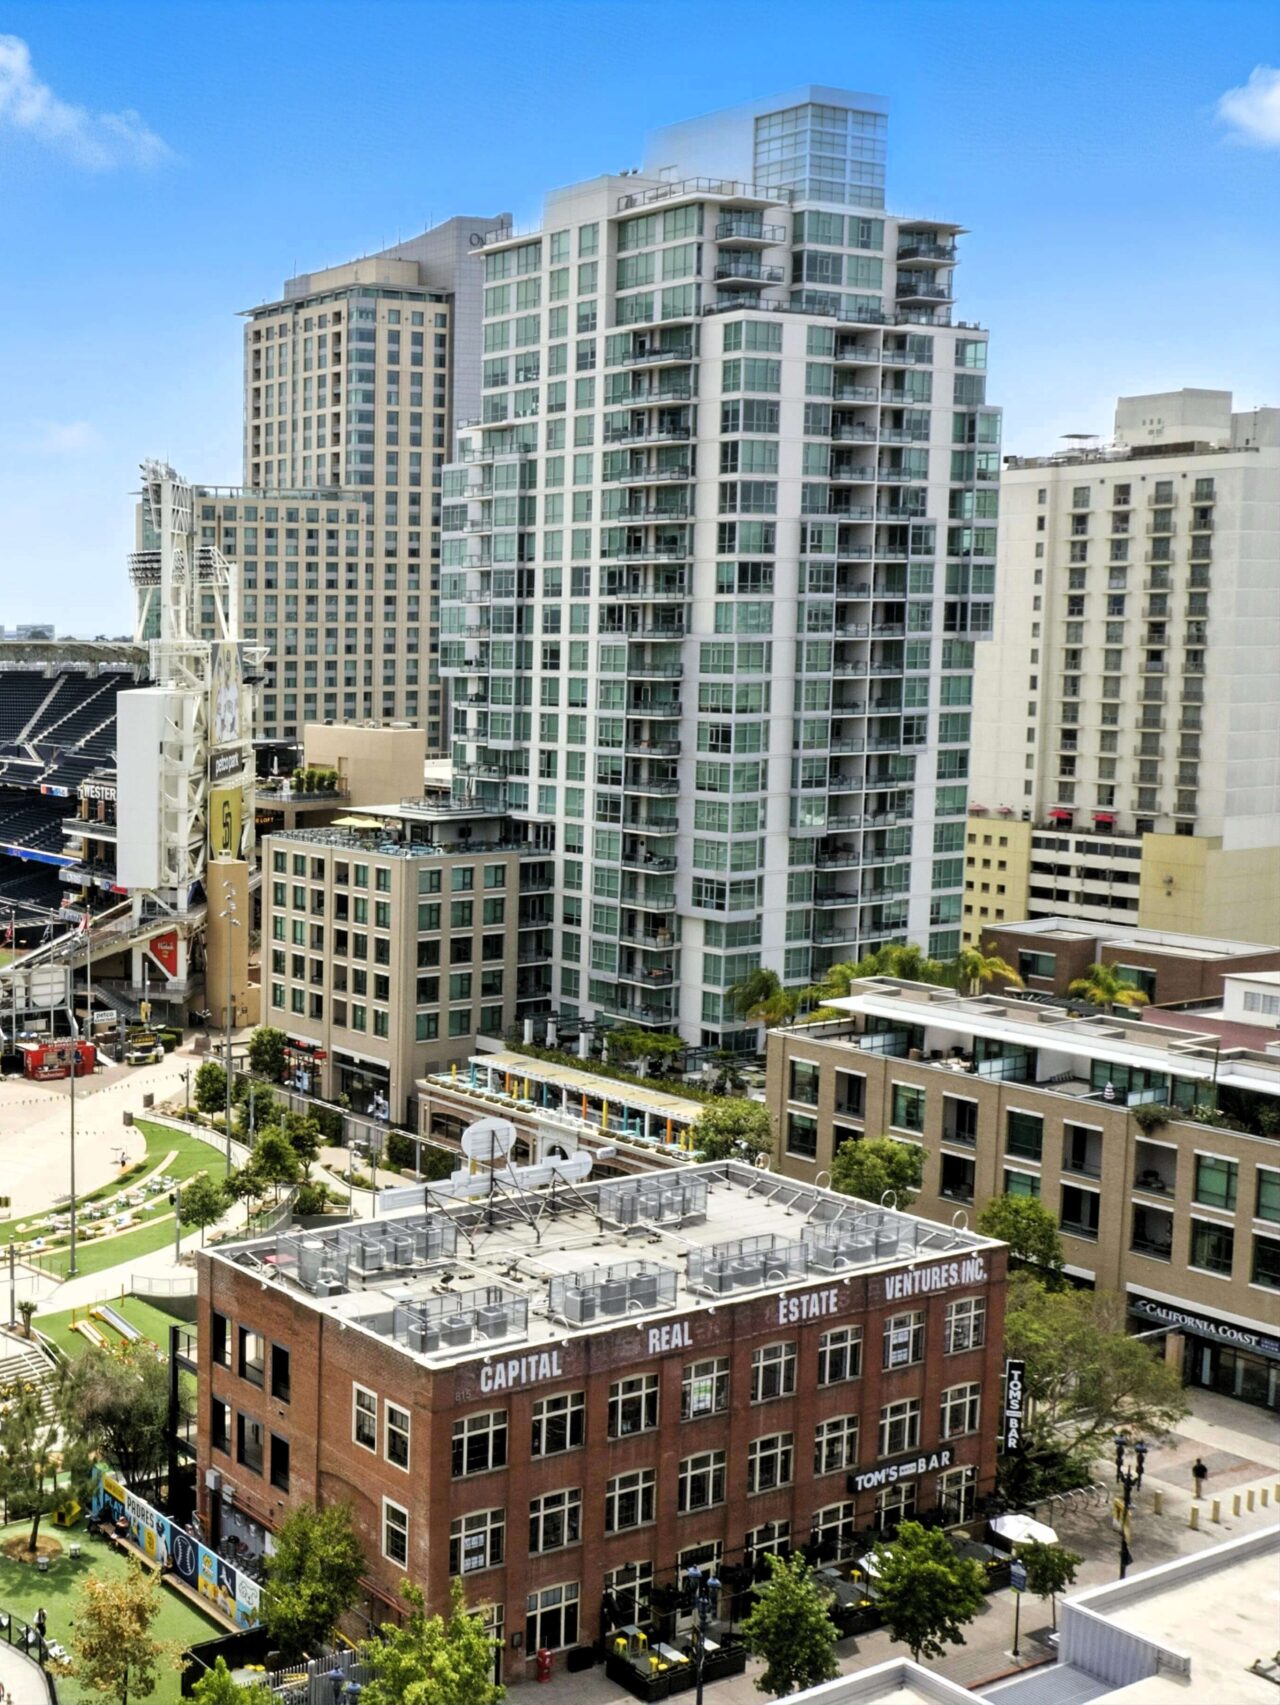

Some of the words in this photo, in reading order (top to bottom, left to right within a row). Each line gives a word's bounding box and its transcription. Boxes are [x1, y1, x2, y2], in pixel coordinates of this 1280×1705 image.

[480, 1350, 562, 1393] CAPITAL
[649, 1320, 693, 1354] REAL
[779, 1288, 838, 1325] ESTATE
[885, 1261, 958, 1301] VENTURES
[961, 1257, 988, 1284] INC.
[1146, 1303, 1216, 1333] CALIFORNIA
[1218, 1325, 1260, 1346] COAST
[1007, 1417, 1019, 1448] BAR
[855, 1465, 898, 1490] TOM'S
[917, 1451, 951, 1473] BAR
[127, 1496, 154, 1529] PADRES
